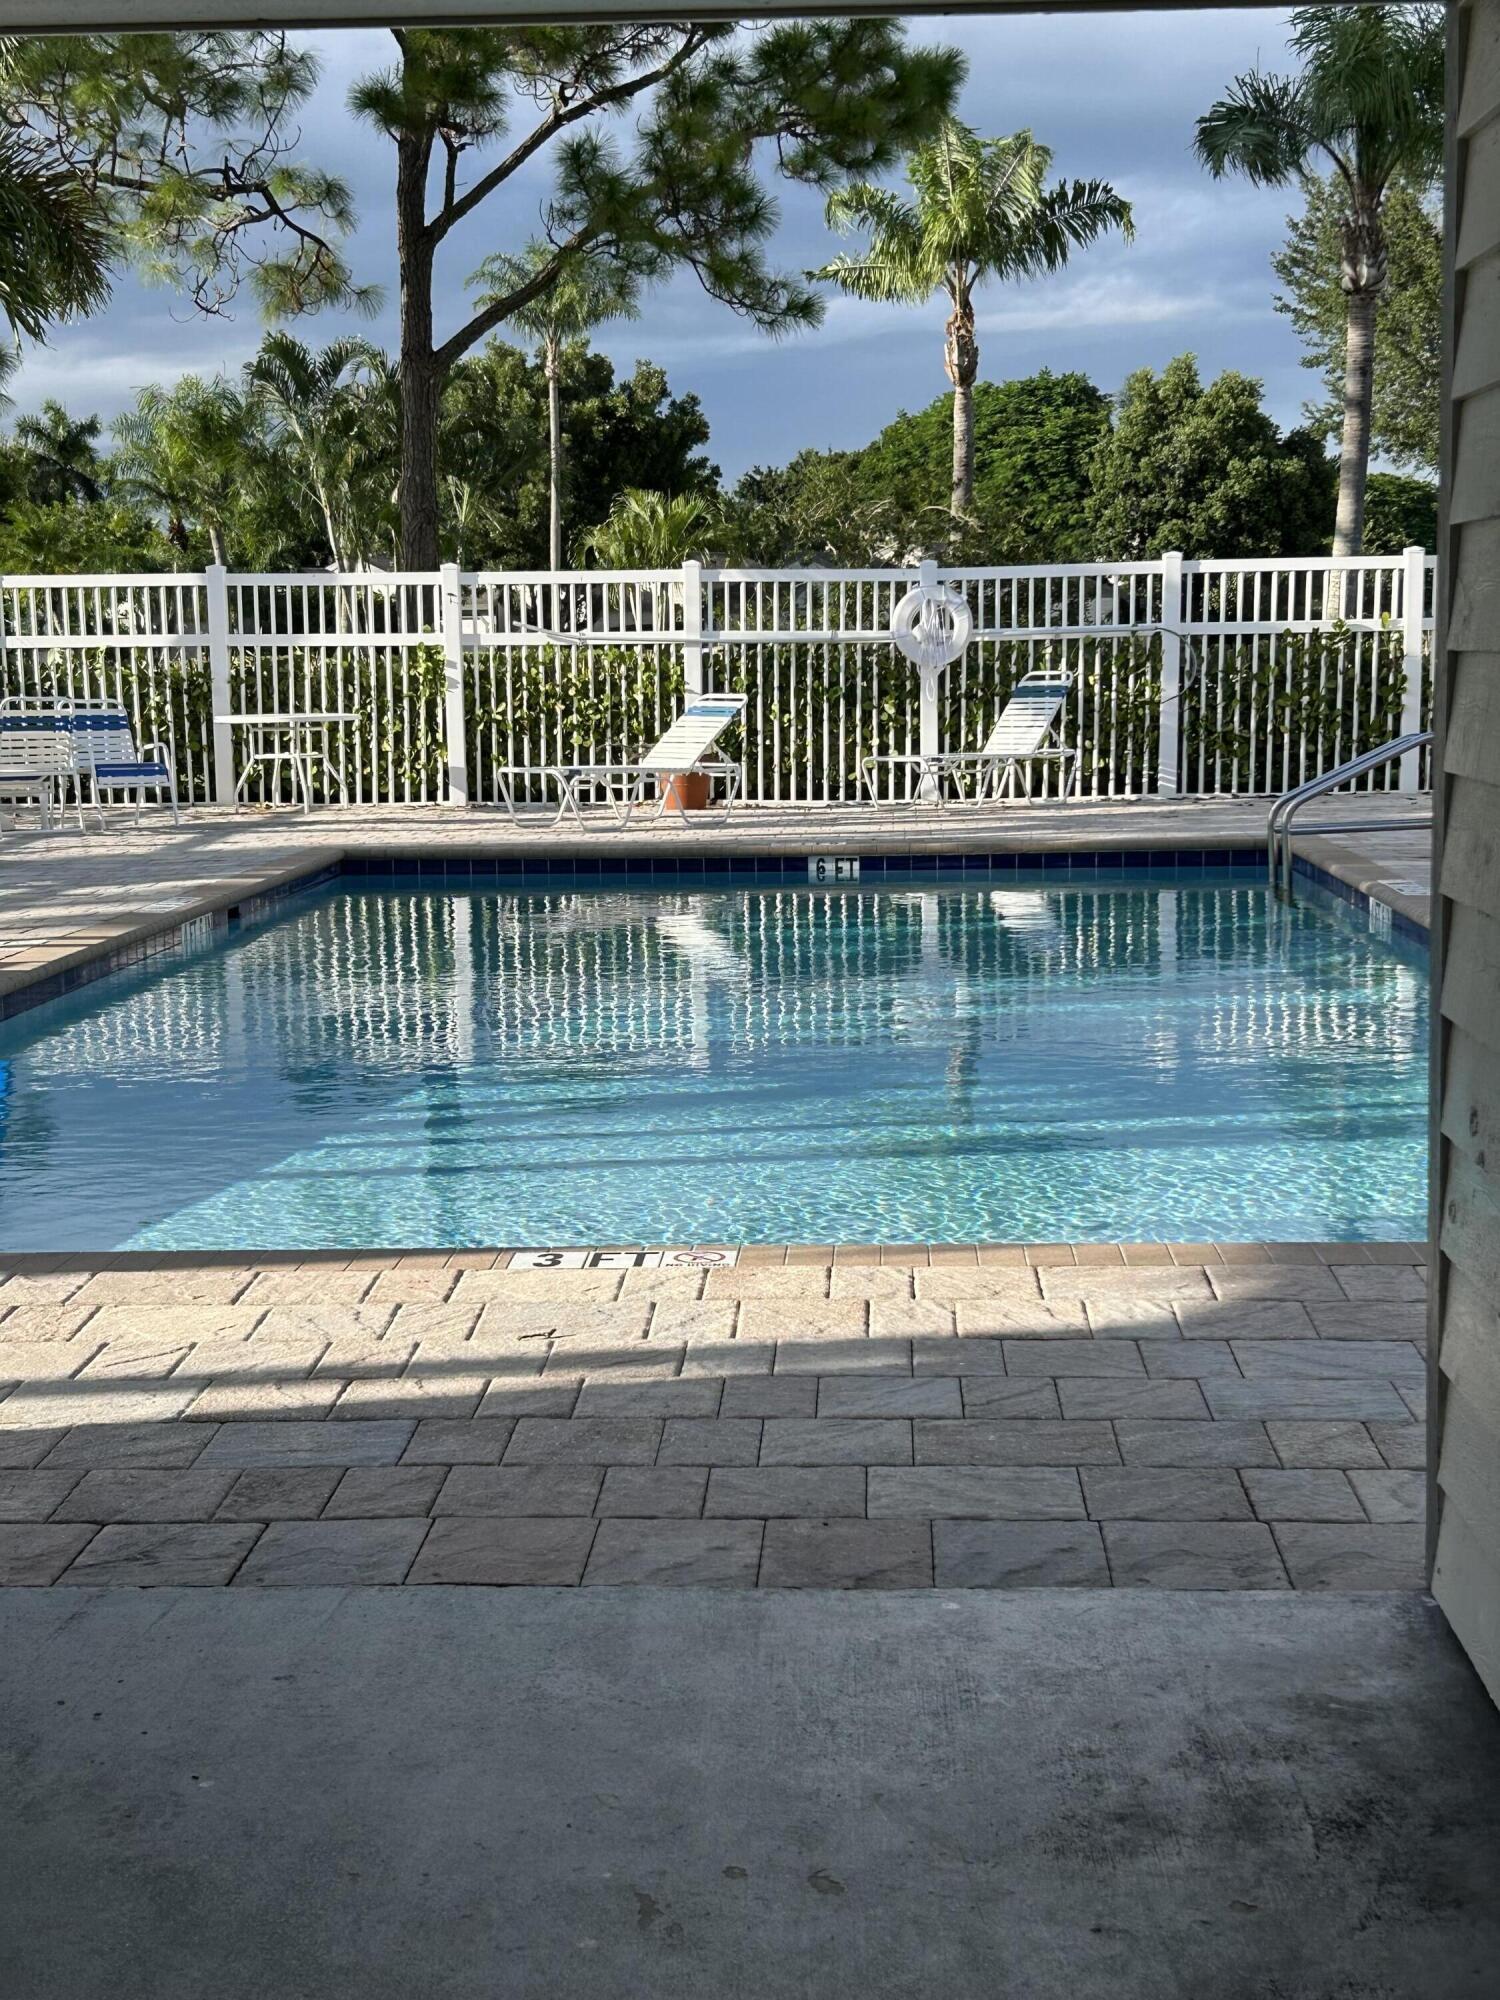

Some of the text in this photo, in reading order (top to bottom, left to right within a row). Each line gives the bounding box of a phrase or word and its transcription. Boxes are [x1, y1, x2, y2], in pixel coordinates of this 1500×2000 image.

[816, 857, 858, 876] 6 FT
[532, 1252, 660, 1268] 3 FT
